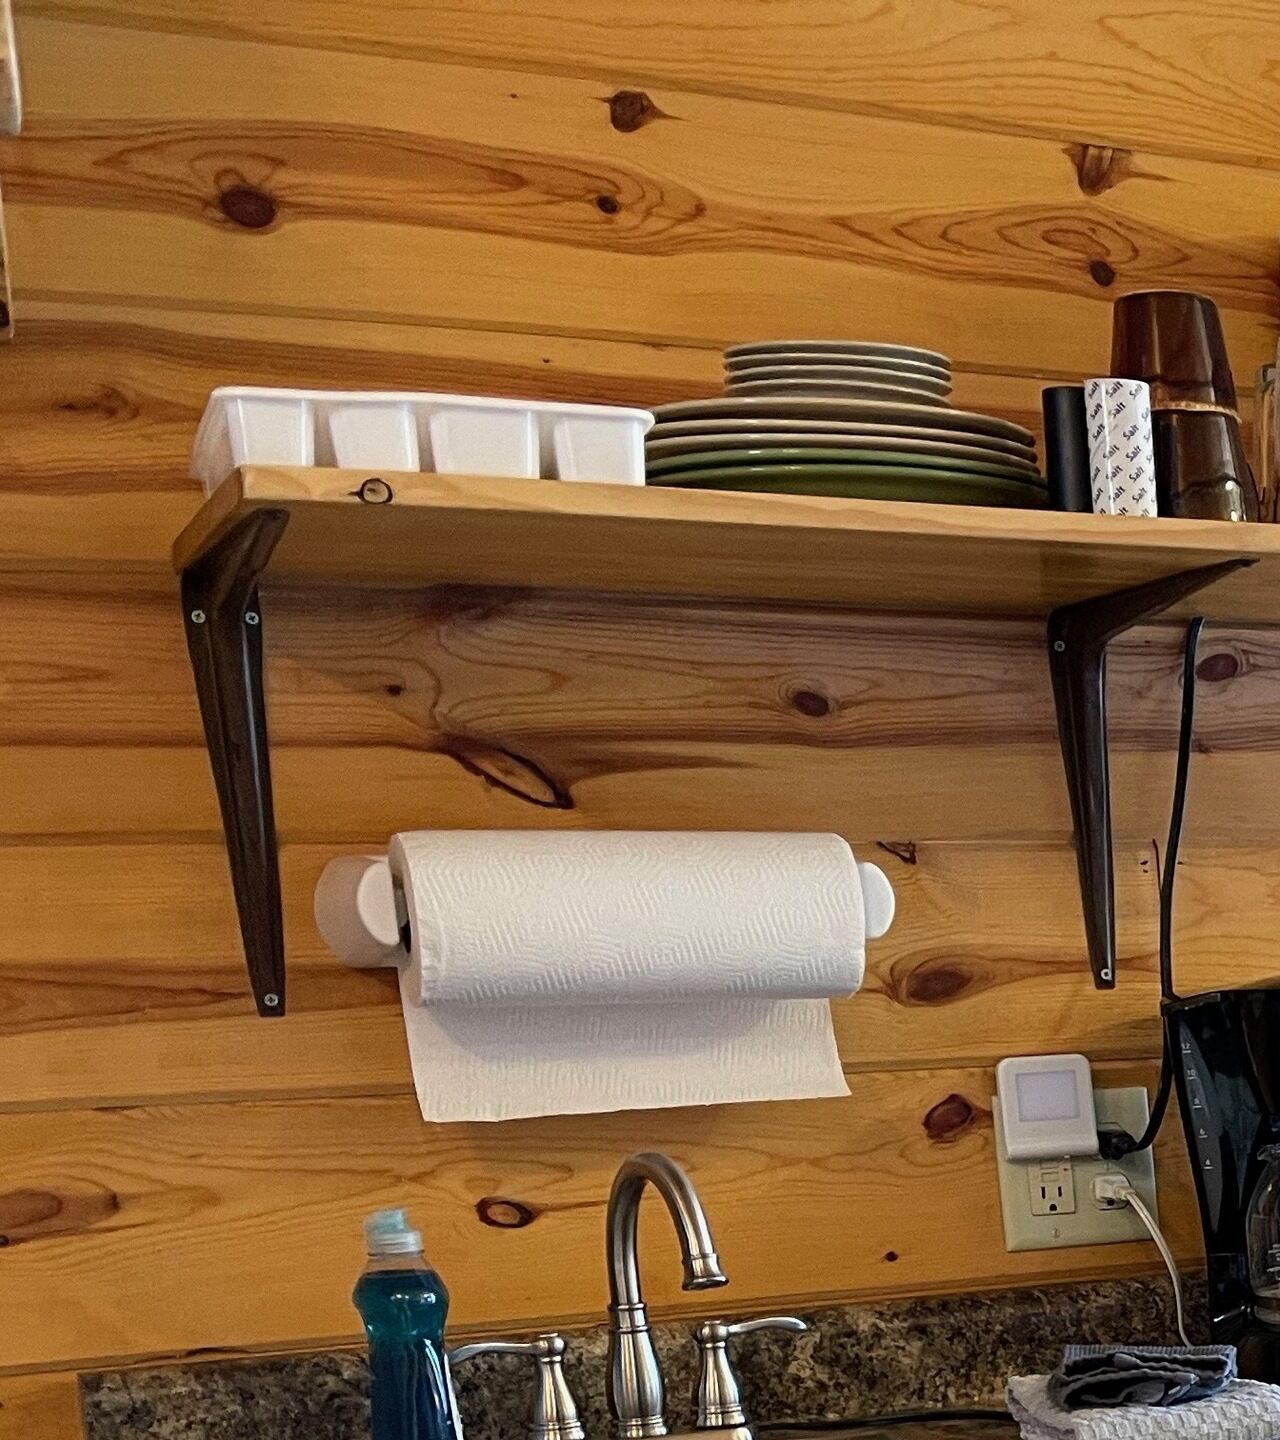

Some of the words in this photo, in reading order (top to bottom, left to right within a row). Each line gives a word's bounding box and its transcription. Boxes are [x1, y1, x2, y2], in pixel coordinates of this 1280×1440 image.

[1105, 381, 1123, 398] Salt
[1129, 383, 1144, 400] Salt
[1092, 424, 1106, 441] Salt
[1122, 424, 1140, 441] Salt
[1102, 444, 1120, 460] Salt
[1125, 445, 1142, 462] Salt
[1129, 466, 1145, 483] Salt
[1131, 487, 1148, 504] Salt
